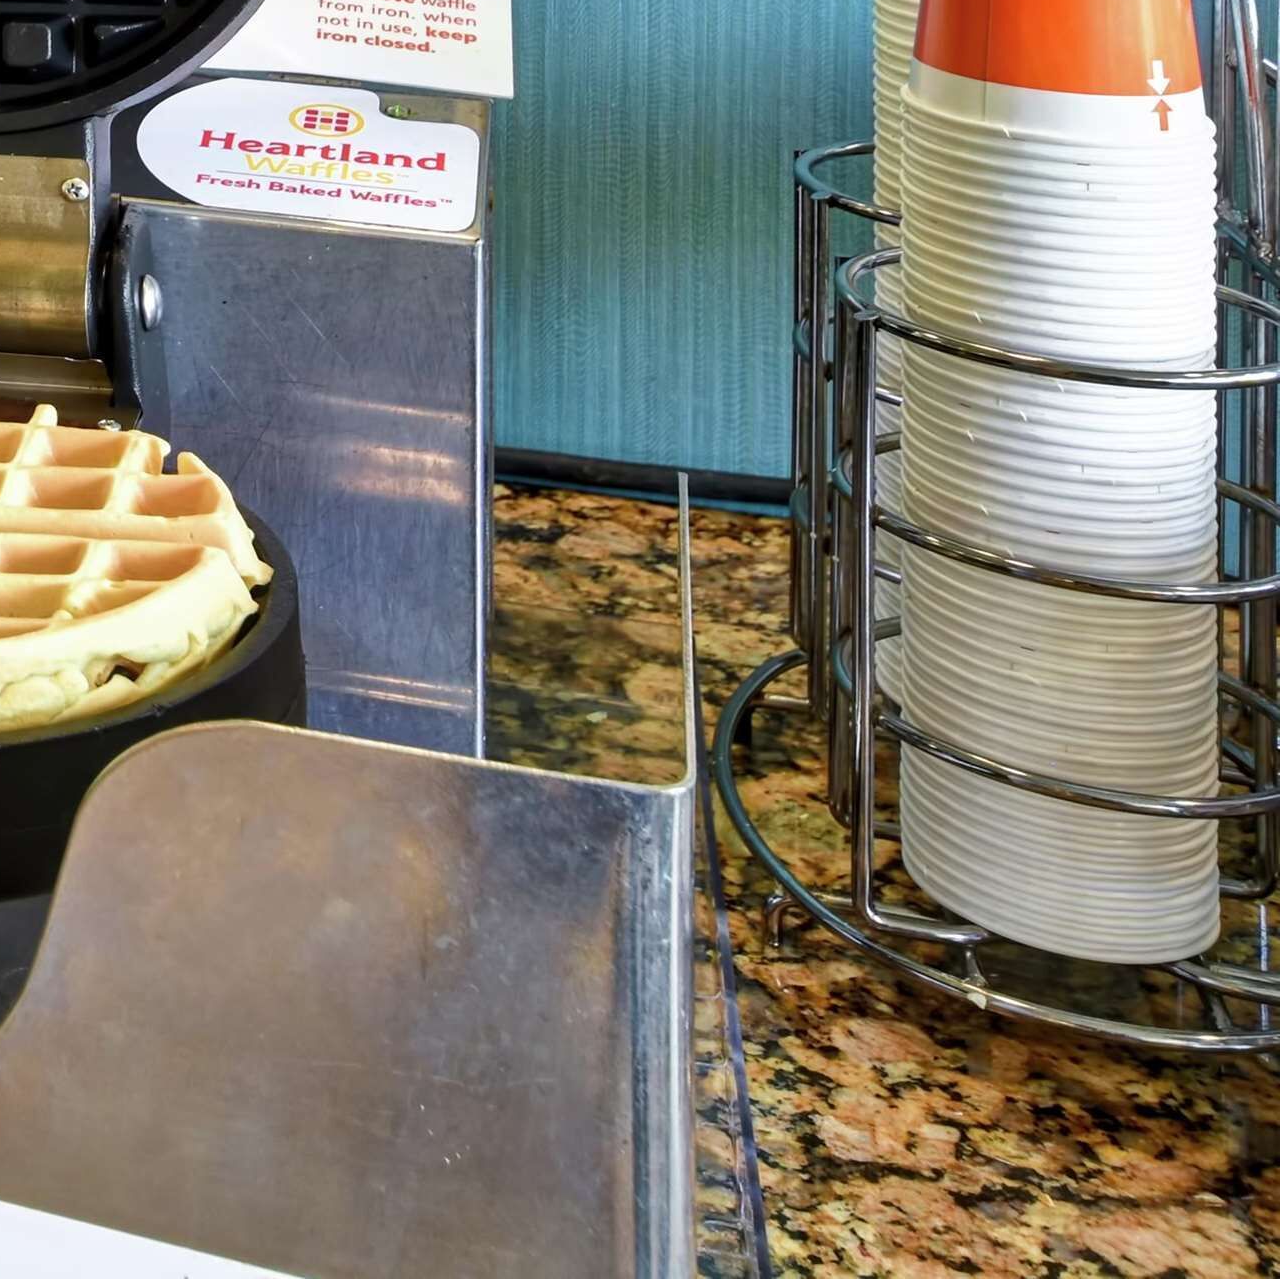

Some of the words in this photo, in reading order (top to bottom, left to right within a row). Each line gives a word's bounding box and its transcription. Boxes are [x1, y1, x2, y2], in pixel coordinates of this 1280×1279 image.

[372, 3, 417, 20] iron.
[423, 10, 477, 27] when
[316, 28, 357, 44] iron
[364, 35, 436, 54] closed.
[317, 15, 350, 28] not
[357, 17, 373, 30] in
[381, 23, 418, 37] use,
[425, 26, 478, 44] keep
[199, 130, 446, 172] Heartland
[195, 174, 260, 191] Fresh
[268, 181, 341, 199] Baked
